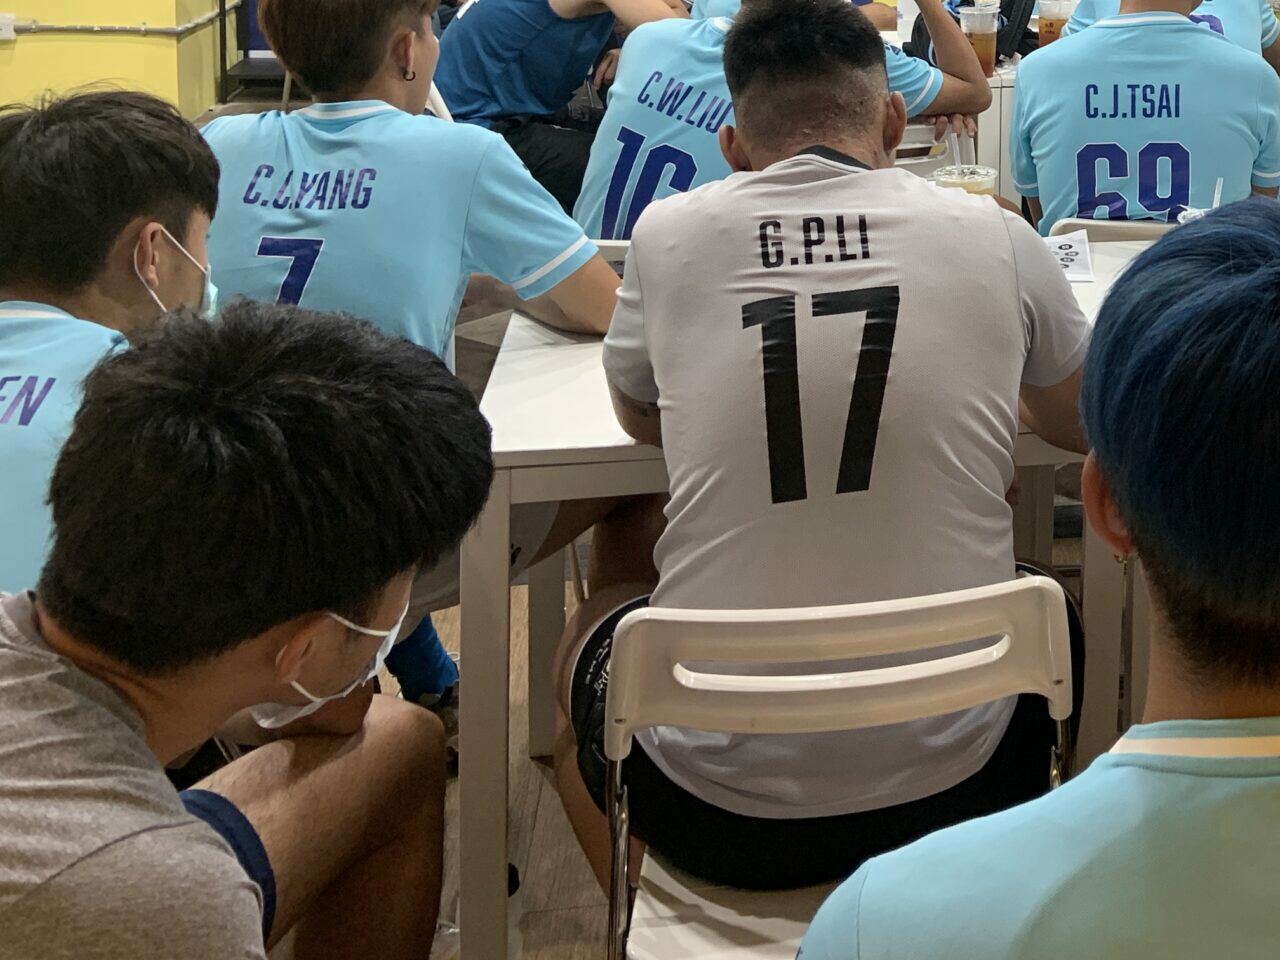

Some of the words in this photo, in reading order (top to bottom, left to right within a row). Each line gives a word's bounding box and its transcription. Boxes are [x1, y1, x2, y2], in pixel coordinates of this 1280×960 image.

[637, 71, 733, 134] C.W.LIU
[1085, 84, 1181, 119] C.J.TSAI
[1076, 141, 1191, 222] 69
[256, 236, 325, 307] 7
[758, 214, 871, 269] G.P.LI
[742, 285, 900, 505] 17
